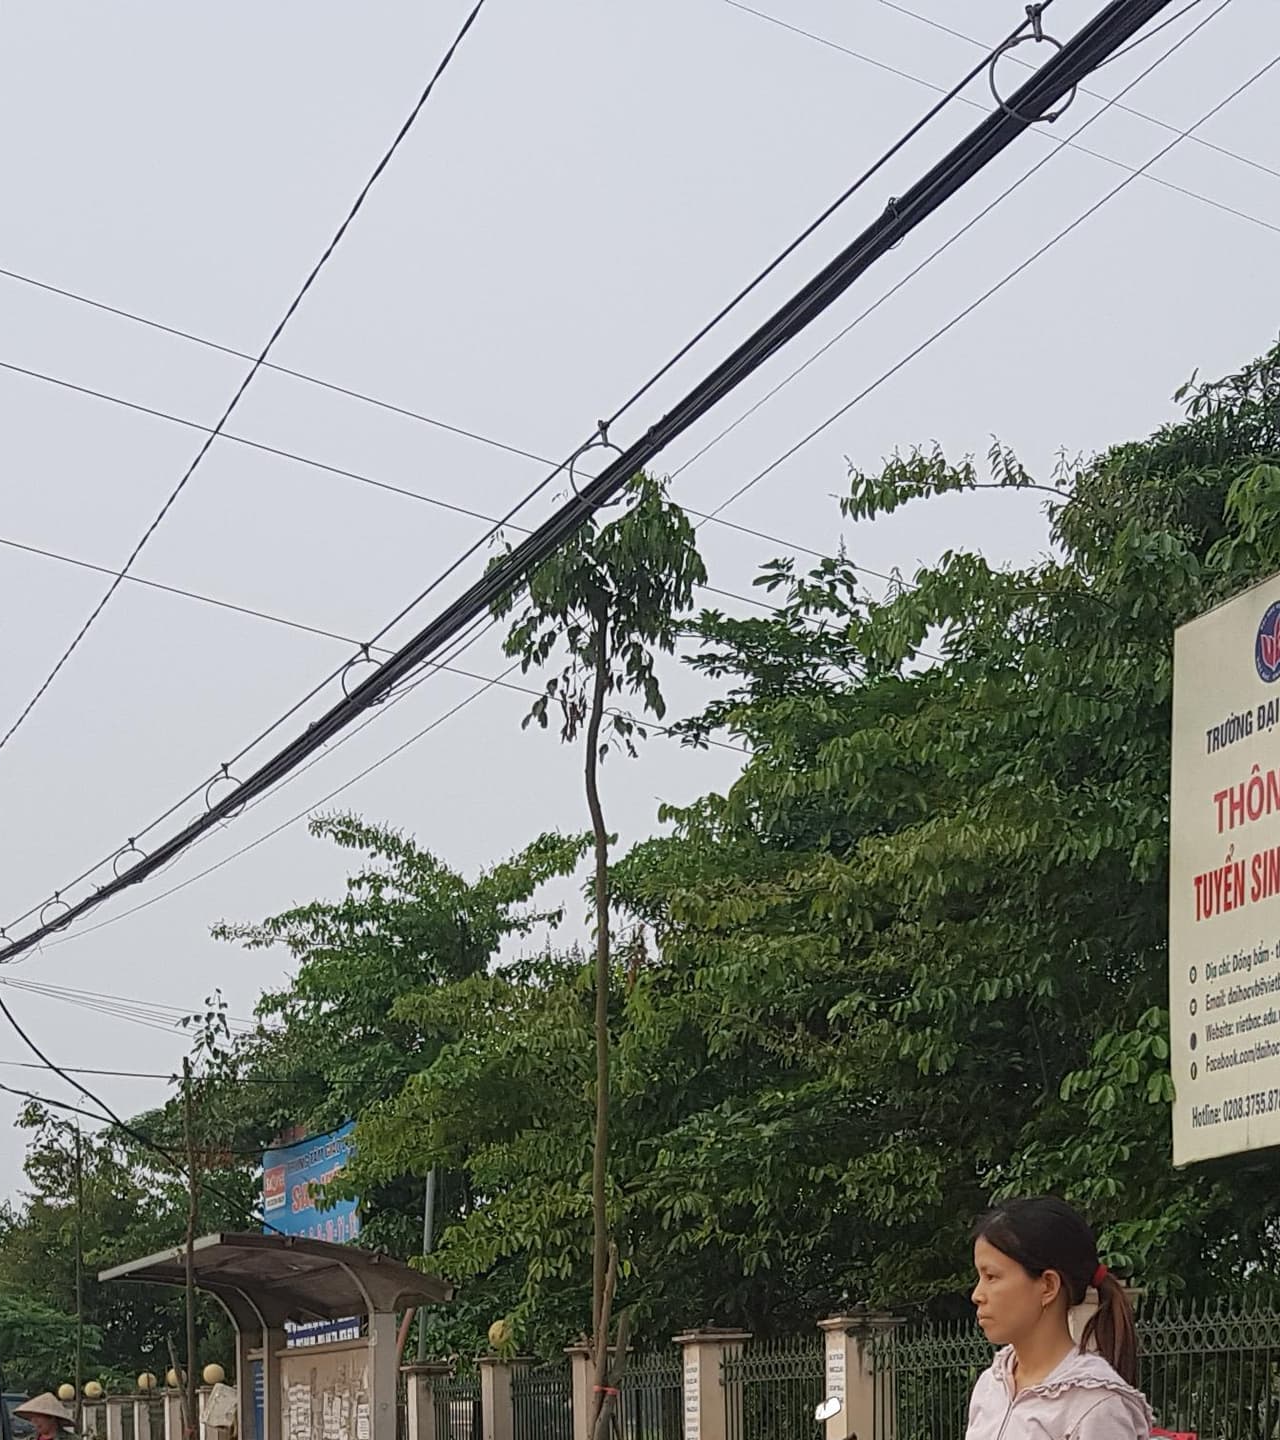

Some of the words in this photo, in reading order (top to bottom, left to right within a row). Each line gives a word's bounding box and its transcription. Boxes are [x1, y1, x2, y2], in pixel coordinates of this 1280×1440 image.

[1207, 711, 1252, 754] TRƯỜNG
[1258, 699, 1279, 732] ĐẠI
[1195, 844, 1245, 921] TUYỂN
[1193, 1103, 1220, 1127] Hotline:
